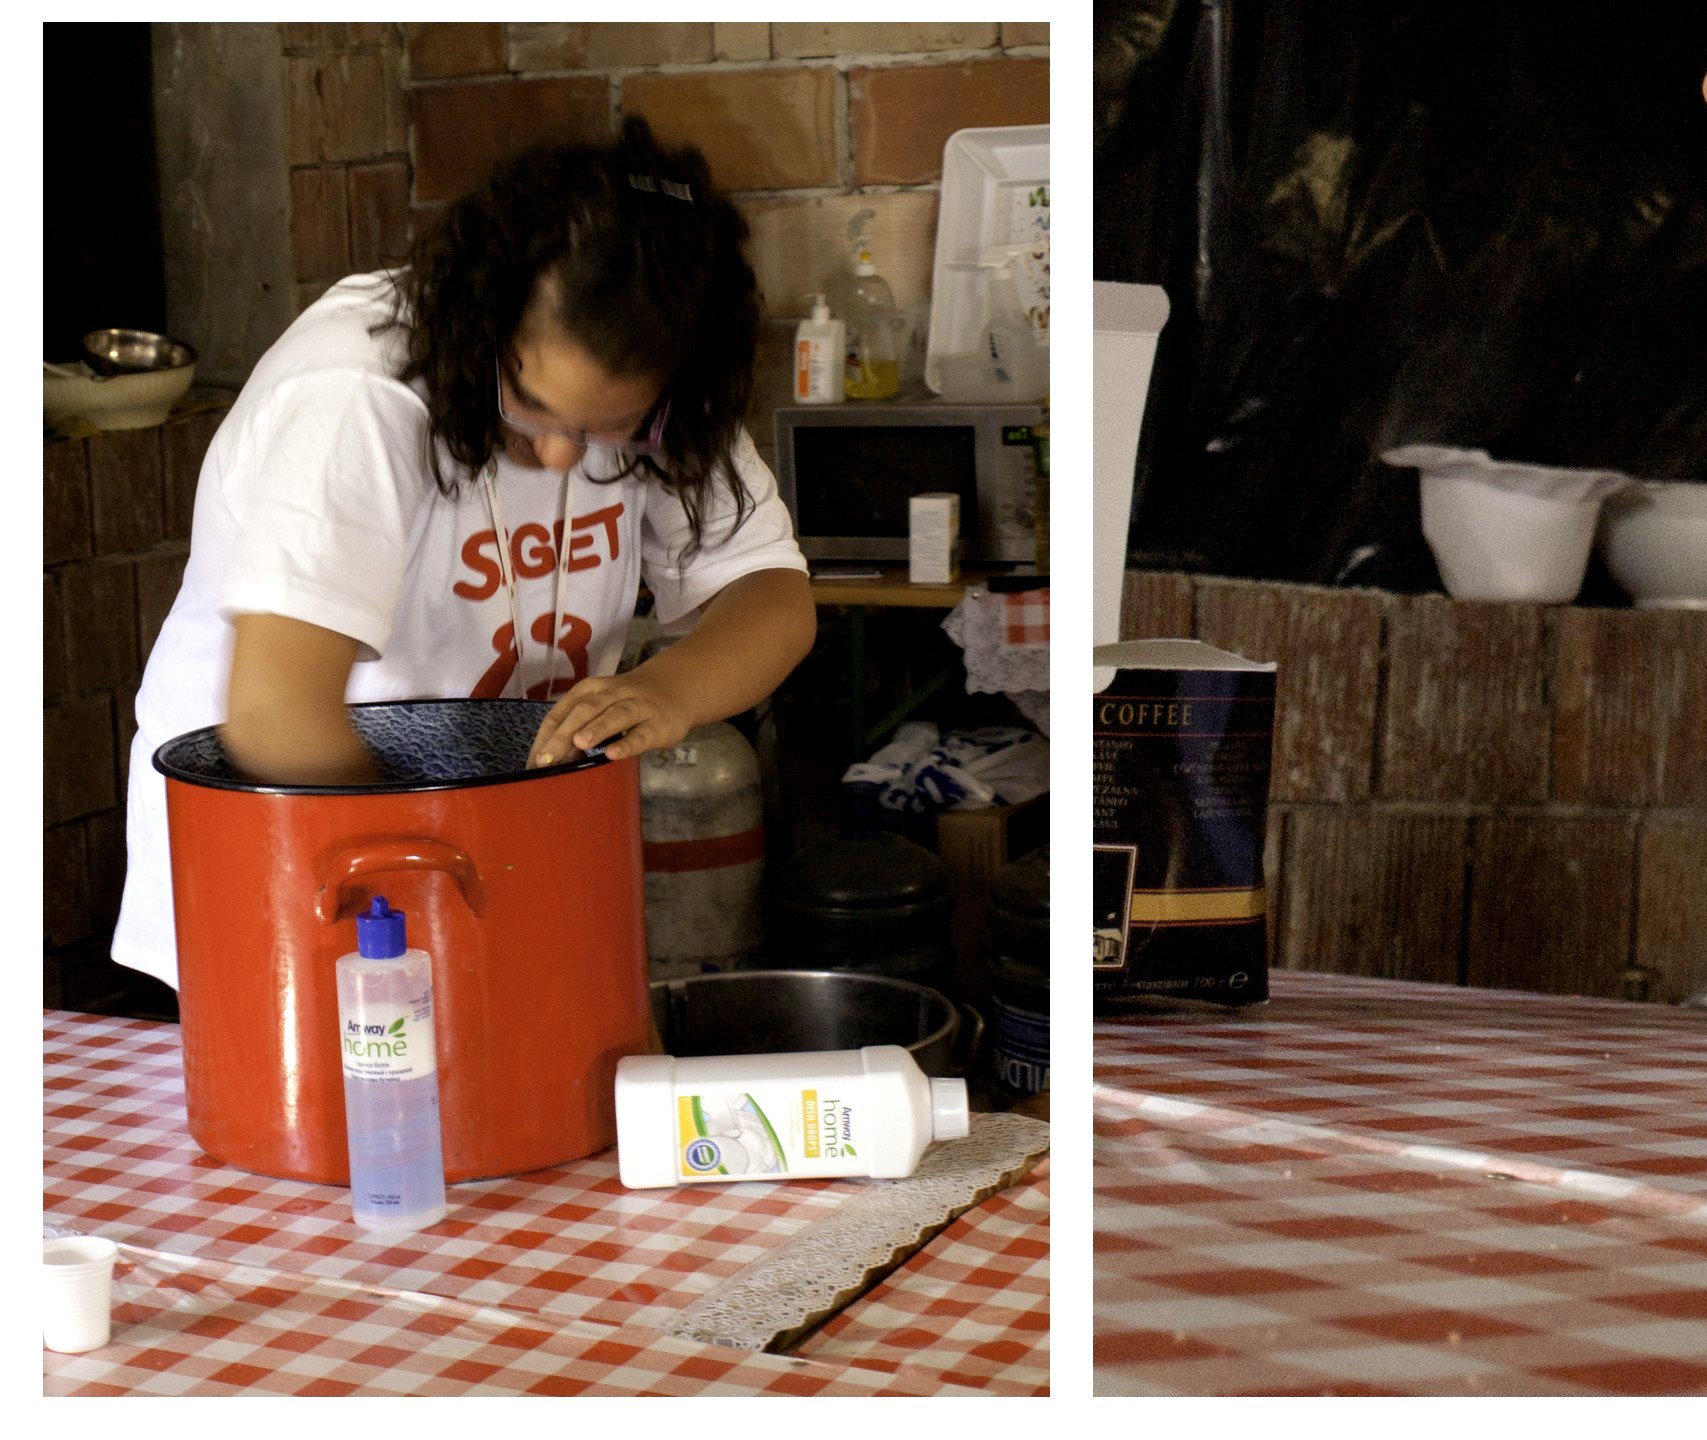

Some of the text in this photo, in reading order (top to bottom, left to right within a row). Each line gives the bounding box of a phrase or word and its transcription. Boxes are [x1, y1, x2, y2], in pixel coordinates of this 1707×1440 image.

[1099, 703, 1194, 726] COFFEE
[347, 1019, 386, 1037] Amway
[343, 1031, 408, 1058] home
[804, 1100, 817, 1152] DISH DROPS
[822, 1099, 841, 1159] home
[841, 1106, 852, 1142] Amway
